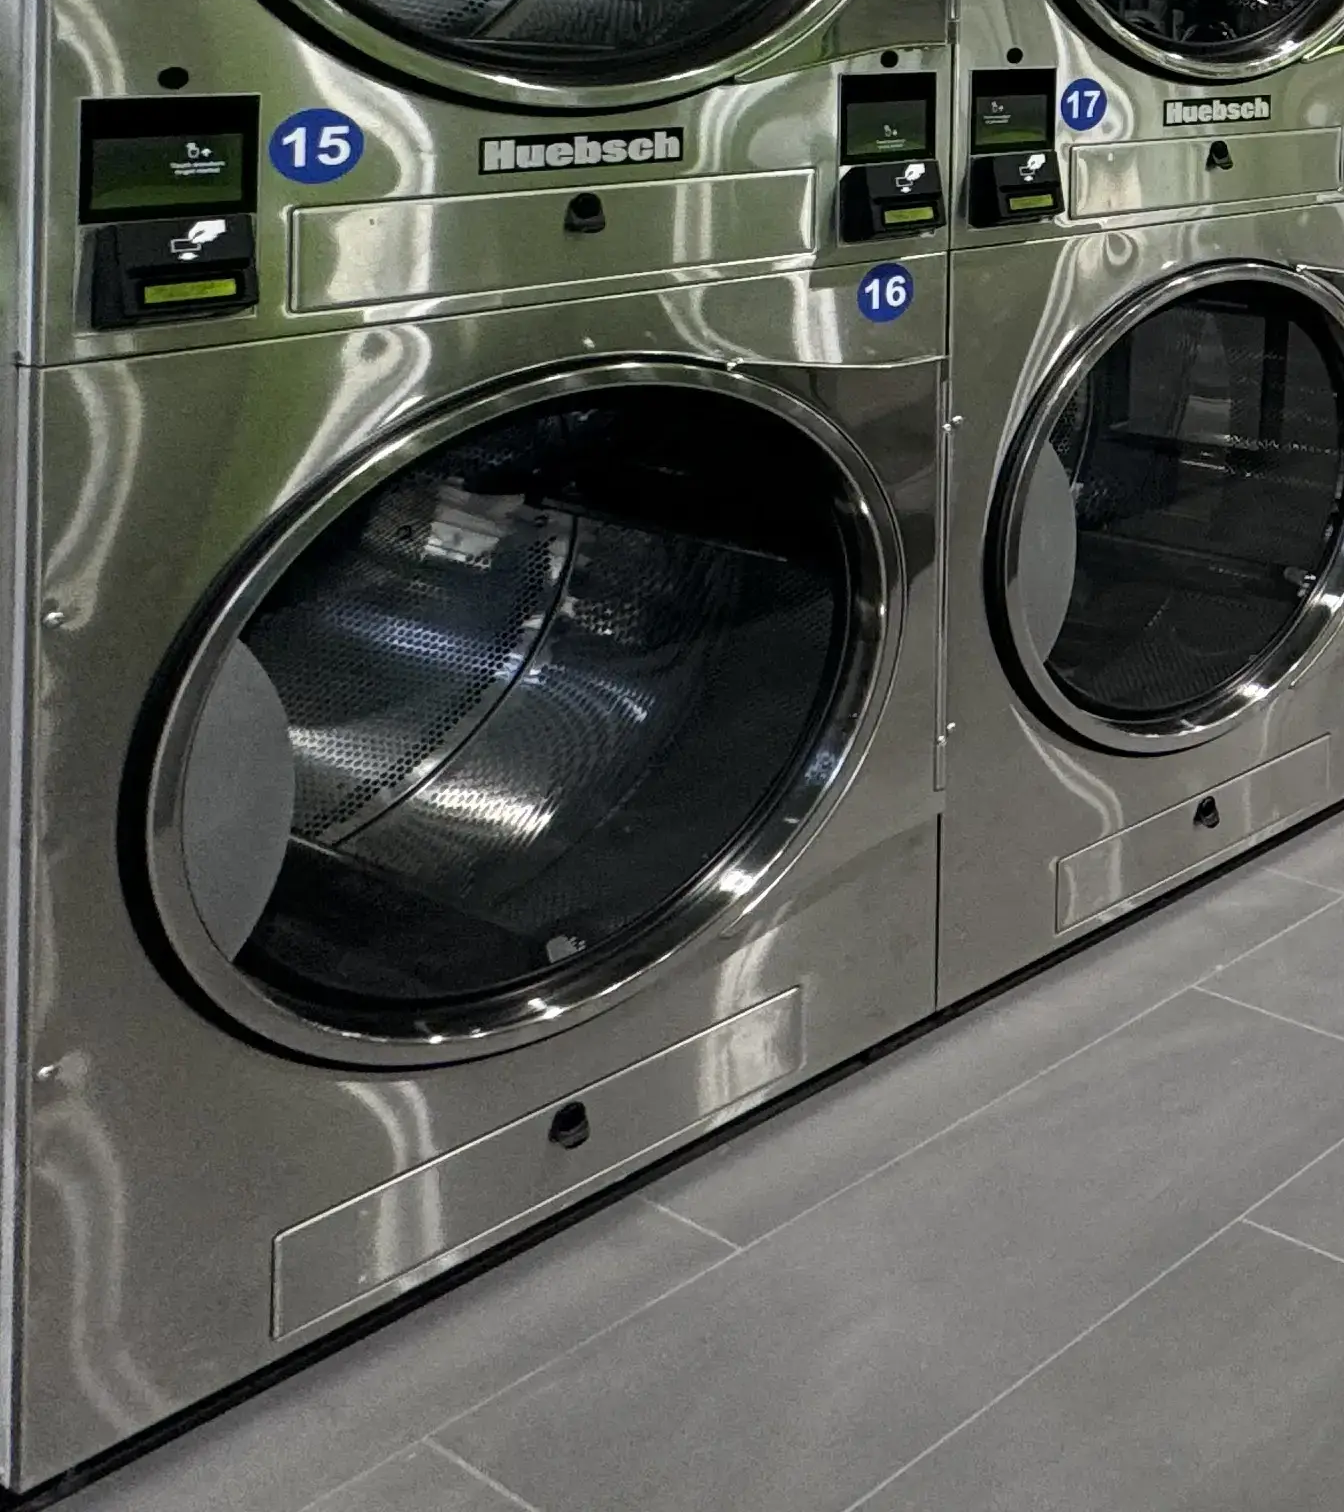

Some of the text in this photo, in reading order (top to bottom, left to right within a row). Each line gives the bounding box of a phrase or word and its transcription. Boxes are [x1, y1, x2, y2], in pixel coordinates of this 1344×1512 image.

[1066, 90, 1101, 120] 17
[1165, 97, 1271, 124] Huebsch
[282, 125, 351, 168] 15
[483, 131, 681, 171] Huebsch
[864, 275, 907, 310] 16
